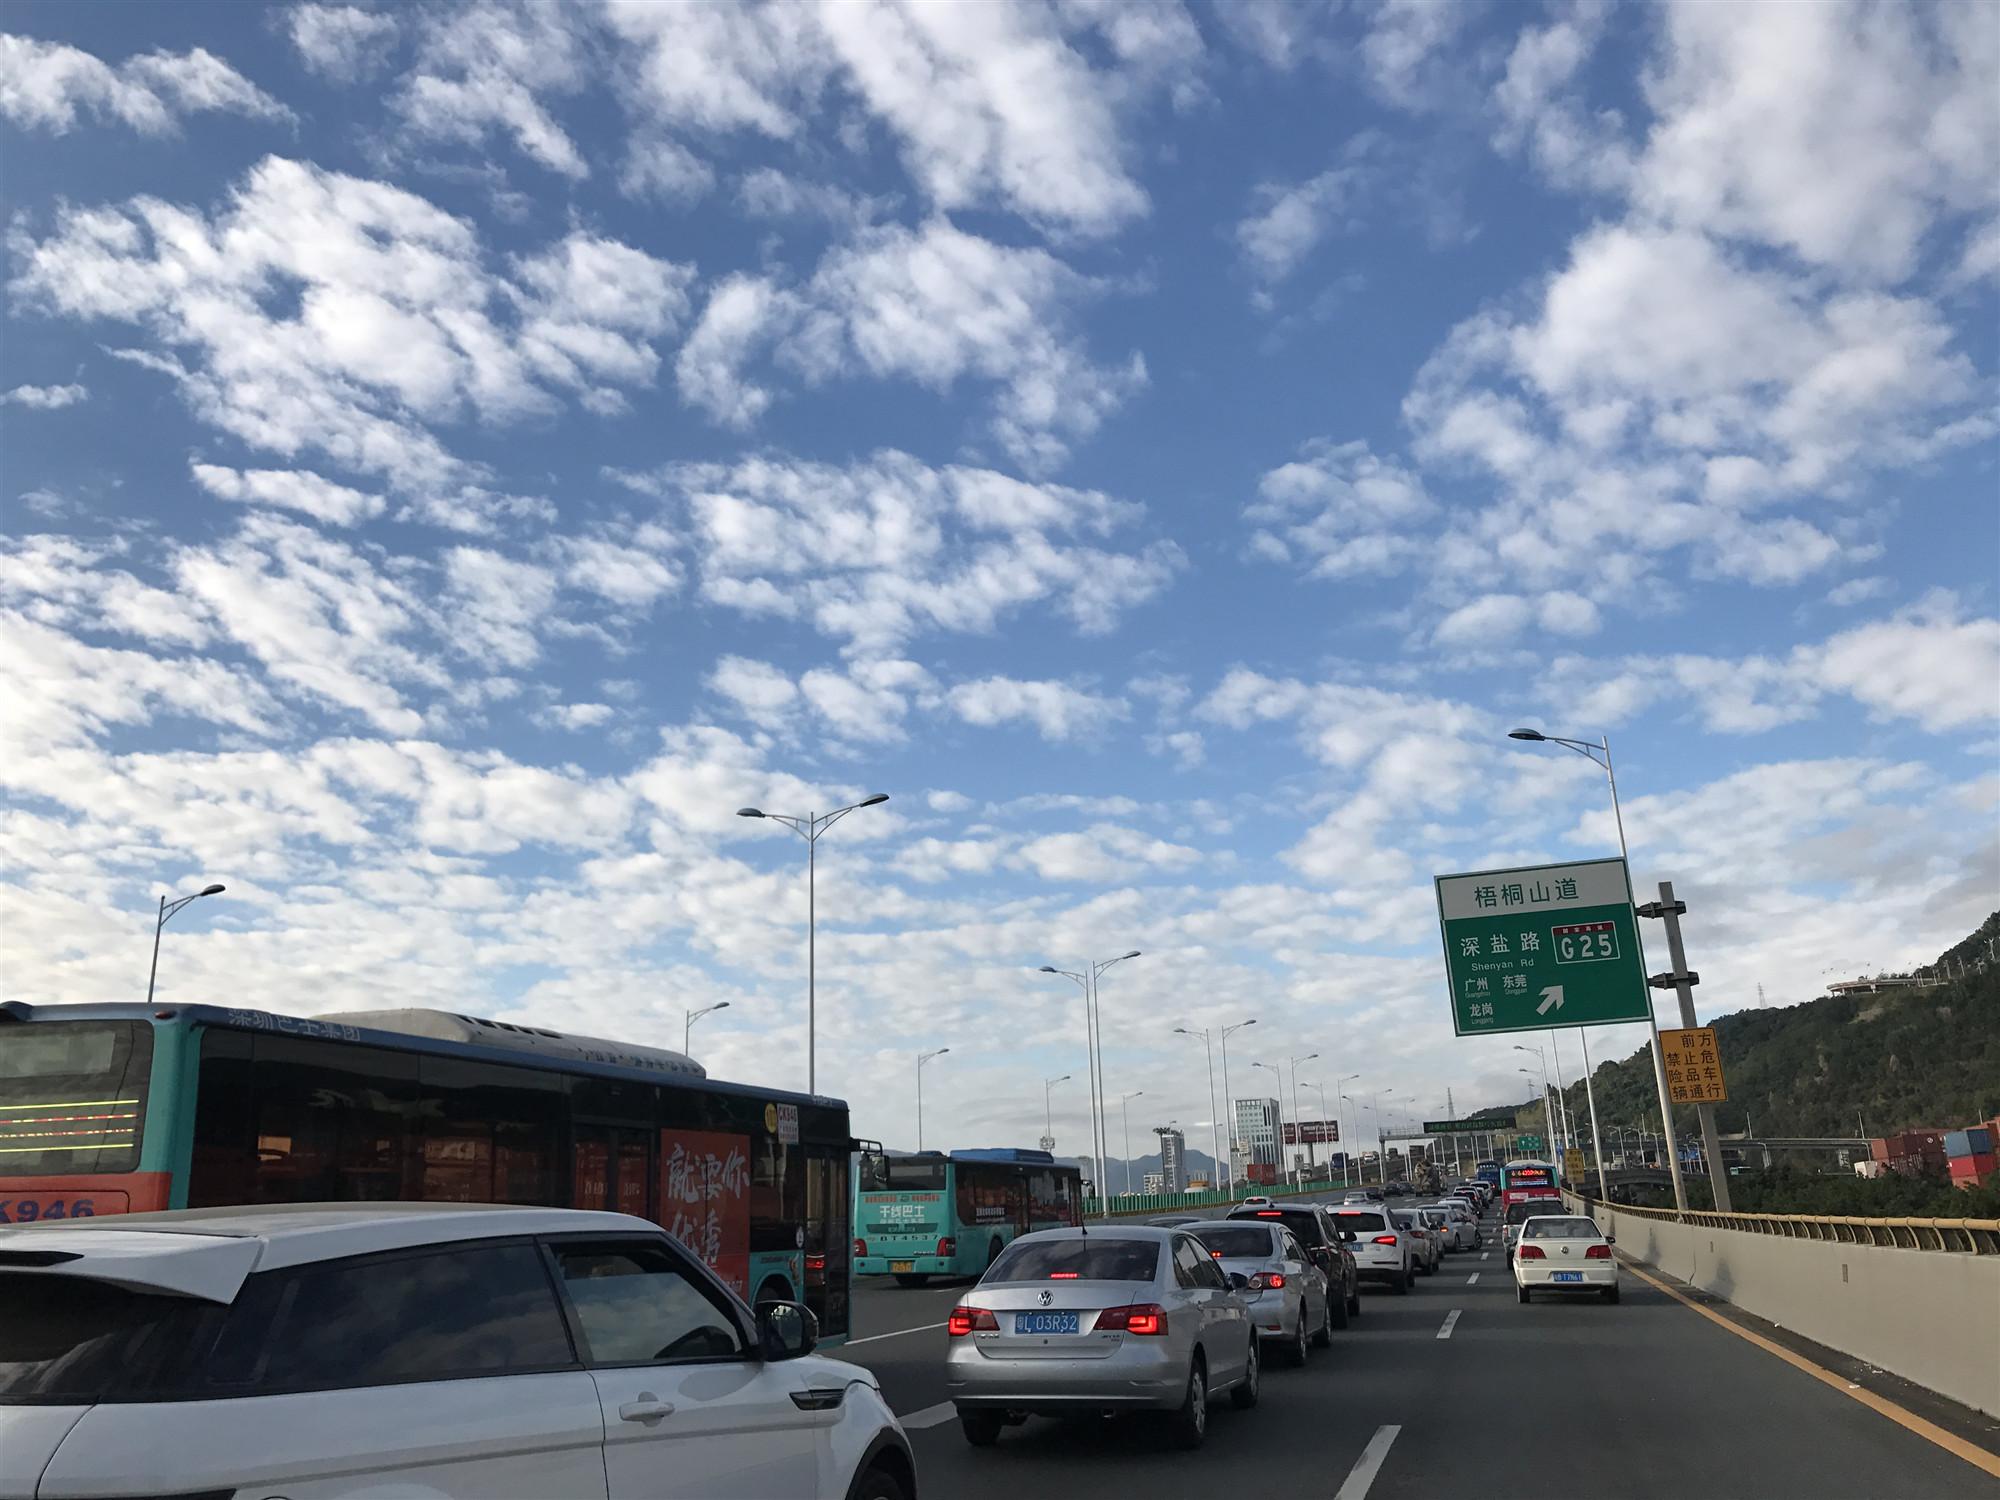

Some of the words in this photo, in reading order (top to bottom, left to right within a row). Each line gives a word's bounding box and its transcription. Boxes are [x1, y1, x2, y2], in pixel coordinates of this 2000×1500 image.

[1474, 877, 1579, 908] 梧桐山道
[1460, 931, 1540, 957] 深盐路
[1561, 933, 1612, 960] G25
[1471, 961, 1514, 971] Shenyan
[1520, 958, 1535, 967] Rd
[1465, 977, 1489, 991] 广州
[1502, 974, 1527, 988] 东莞
[1469, 1003, 1493, 1016] 龙岗
[1680, 1032, 1711, 1048] 前方
[1666, 1050, 1715, 1067] 禁止危
[1668, 1066, 1717, 1084] 险品车
[1672, 1083, 1721, 1100] 辆通行
[880, 1205, 925, 1218] 干线巴士
